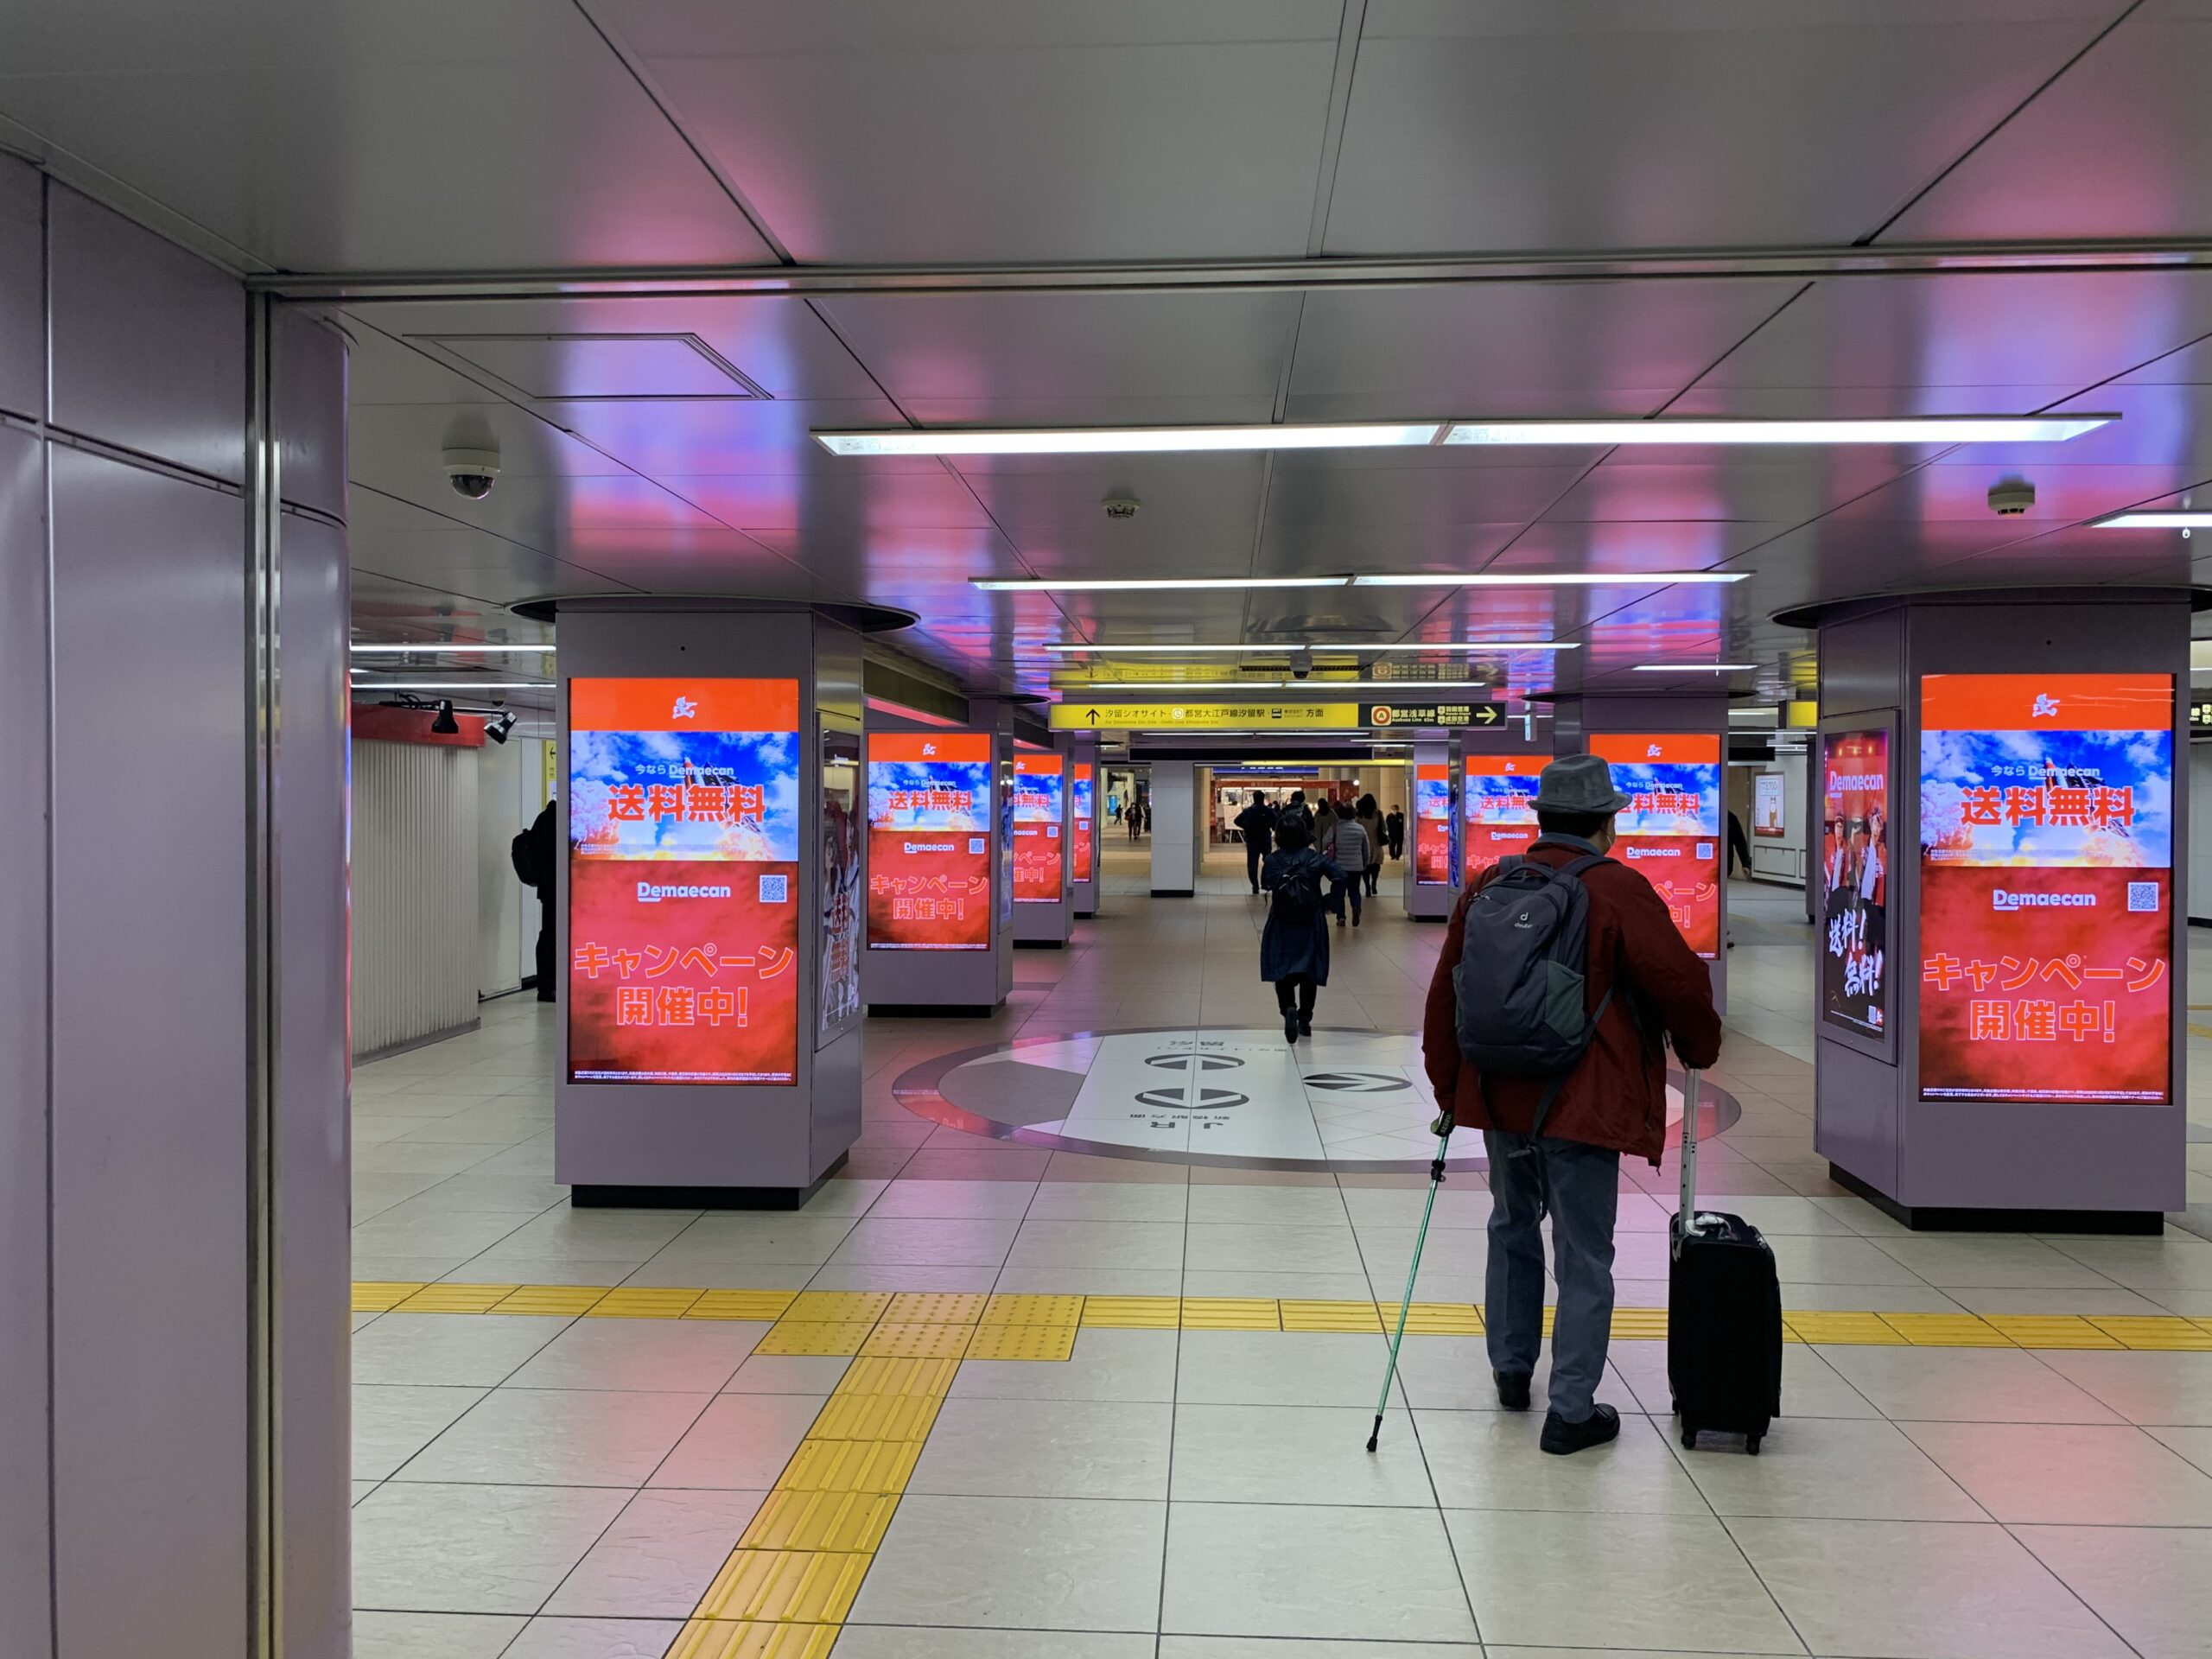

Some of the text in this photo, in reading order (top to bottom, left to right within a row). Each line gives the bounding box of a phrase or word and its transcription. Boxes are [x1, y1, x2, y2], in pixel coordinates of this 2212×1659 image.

[1306, 709, 1324, 718] 方面
[635, 764, 734, 778] 今なら Demaecan
[1991, 765, 2101, 779] 今なら Demaecan
[1829, 771, 1884, 798] Demaecan
[607, 784, 766, 823] 送料無料
[888, 791, 973, 810] 送料無料
[1480, 796, 1538, 810] 送料無
[1960, 785, 2135, 827] 送料無料
[1491, 831, 1529, 841] Demaecan
[904, 842, 955, 854] Demaecan
[1626, 847, 1681, 859] Demaecan
[637, 881, 731, 902] Demaecan
[870, 874, 989, 895] キャンペーン
[893, 898, 964, 920] 開催中!
[1993, 889, 2097, 911] Demaecan
[574, 942, 794, 980] キャンペーン
[1923, 952, 2166, 993] キャンペーン
[616, 986, 749, 1028] 開催中!
[1970, 1000, 2115, 1043] 開催中!
